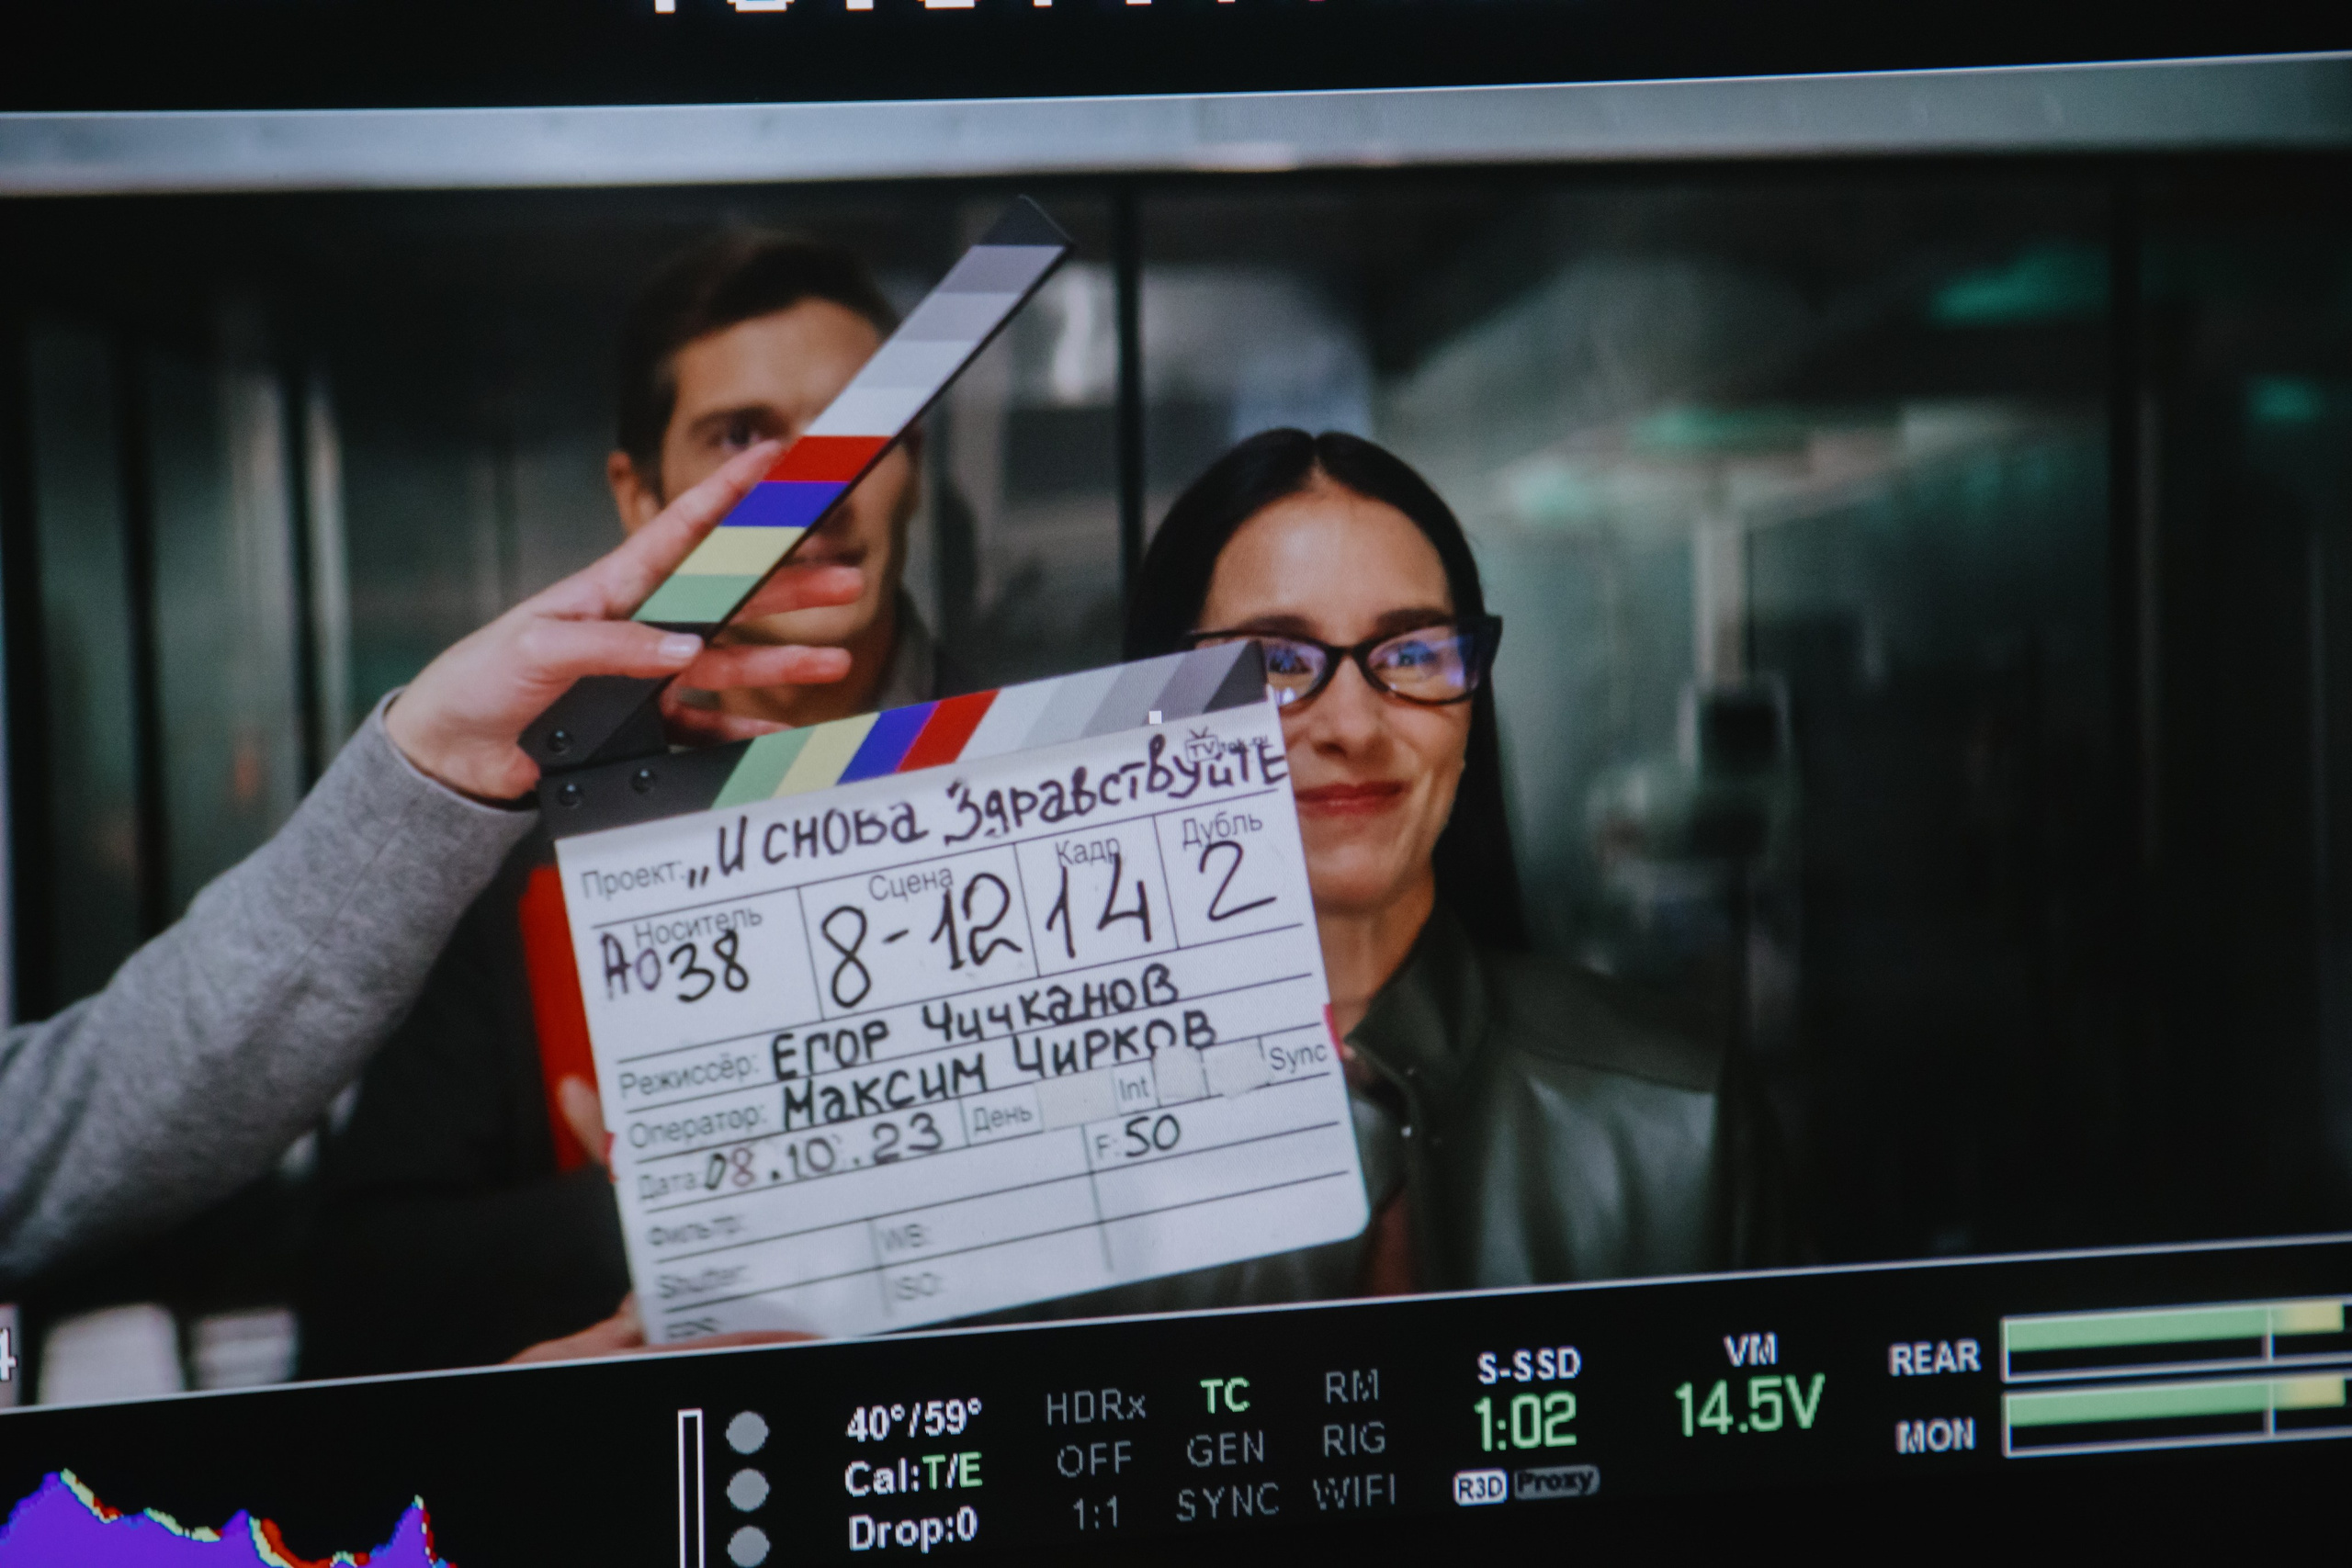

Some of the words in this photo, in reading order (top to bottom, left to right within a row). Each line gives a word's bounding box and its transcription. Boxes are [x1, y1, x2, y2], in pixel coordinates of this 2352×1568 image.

[1182, 811, 1263, 849] Дубль
[1055, 836, 1121, 869] Кадр
[581, 860, 685, 901] Проект:
[868, 867, 955, 903] Сцена
[1198, 840, 1277, 922] 2
[1046, 854, 1153, 959] 14
[633, 908, 763, 950] Носитель
[619, 1053, 761, 1099] Режиссёр:
[1270, 1042, 1329, 1074] Sync
[1118, 1077, 1149, 1102] Int
[628, 1108, 769, 1149] Оператор:
[972, 1104, 1034, 1135] День
[1125, 1113, 1181, 1157] 50
[1477, 1346, 1582, 1385] S-SSD
[1724, 1332, 1779, 1368] VM
[1889, 1338, 1982, 1377] REAR
[1200, 1377, 1250, 1415] TC
[1325, 1368, 1379, 1404] RM
[1674, 1372, 1826, 1438] 14.5V
[846, 1397, 983, 1442] 40°/59°
[1046, 1388, 1147, 1426] HDRx
[1473, 1390, 1577, 1452] 1:02
[1187, 1430, 1265, 1468] GEN
[1323, 1421, 1386, 1458] RIG
[1895, 1416, 1976, 1454] MON
[1057, 1440, 1132, 1478] OFF
[1313, 1473, 1396, 1511] WIFI
[1458, 1477, 1503, 1500] R3D
[1517, 1470, 1594, 1495] Proxy
[1072, 1495, 1118, 1530] 1:1
[1176, 1482, 1280, 1522] SYNC
[848, 1506, 978, 1553] Drop:0
